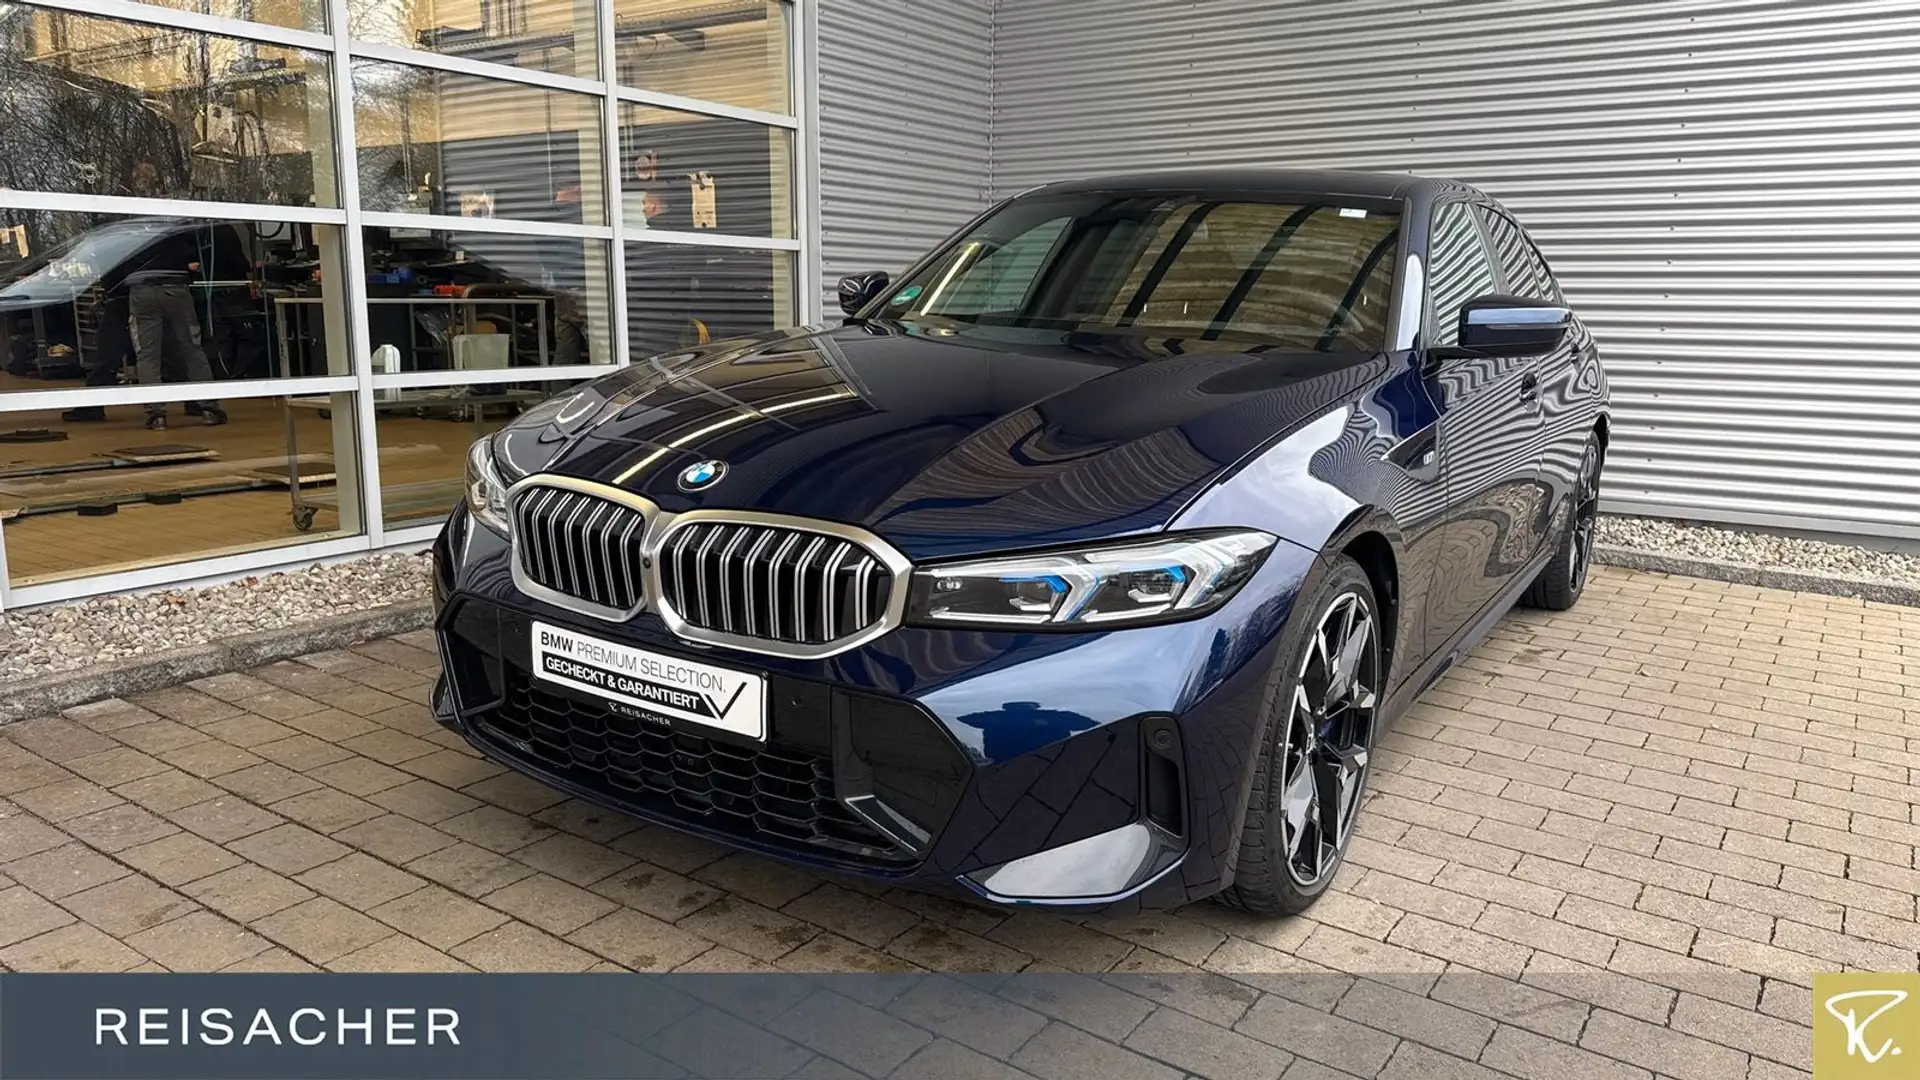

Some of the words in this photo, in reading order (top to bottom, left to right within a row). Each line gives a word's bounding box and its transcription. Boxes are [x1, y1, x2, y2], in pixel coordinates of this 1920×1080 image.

[541, 631, 574, 653] BMW
[577, 641, 637, 672] PREMIUM
[640, 658, 727, 692] SELECTION.
[546, 656, 606, 685] GECHECKT
[607, 675, 617, 688] &
[617, 677, 700, 710] GARANTIERT
[620, 706, 671, 726] REISACHER
